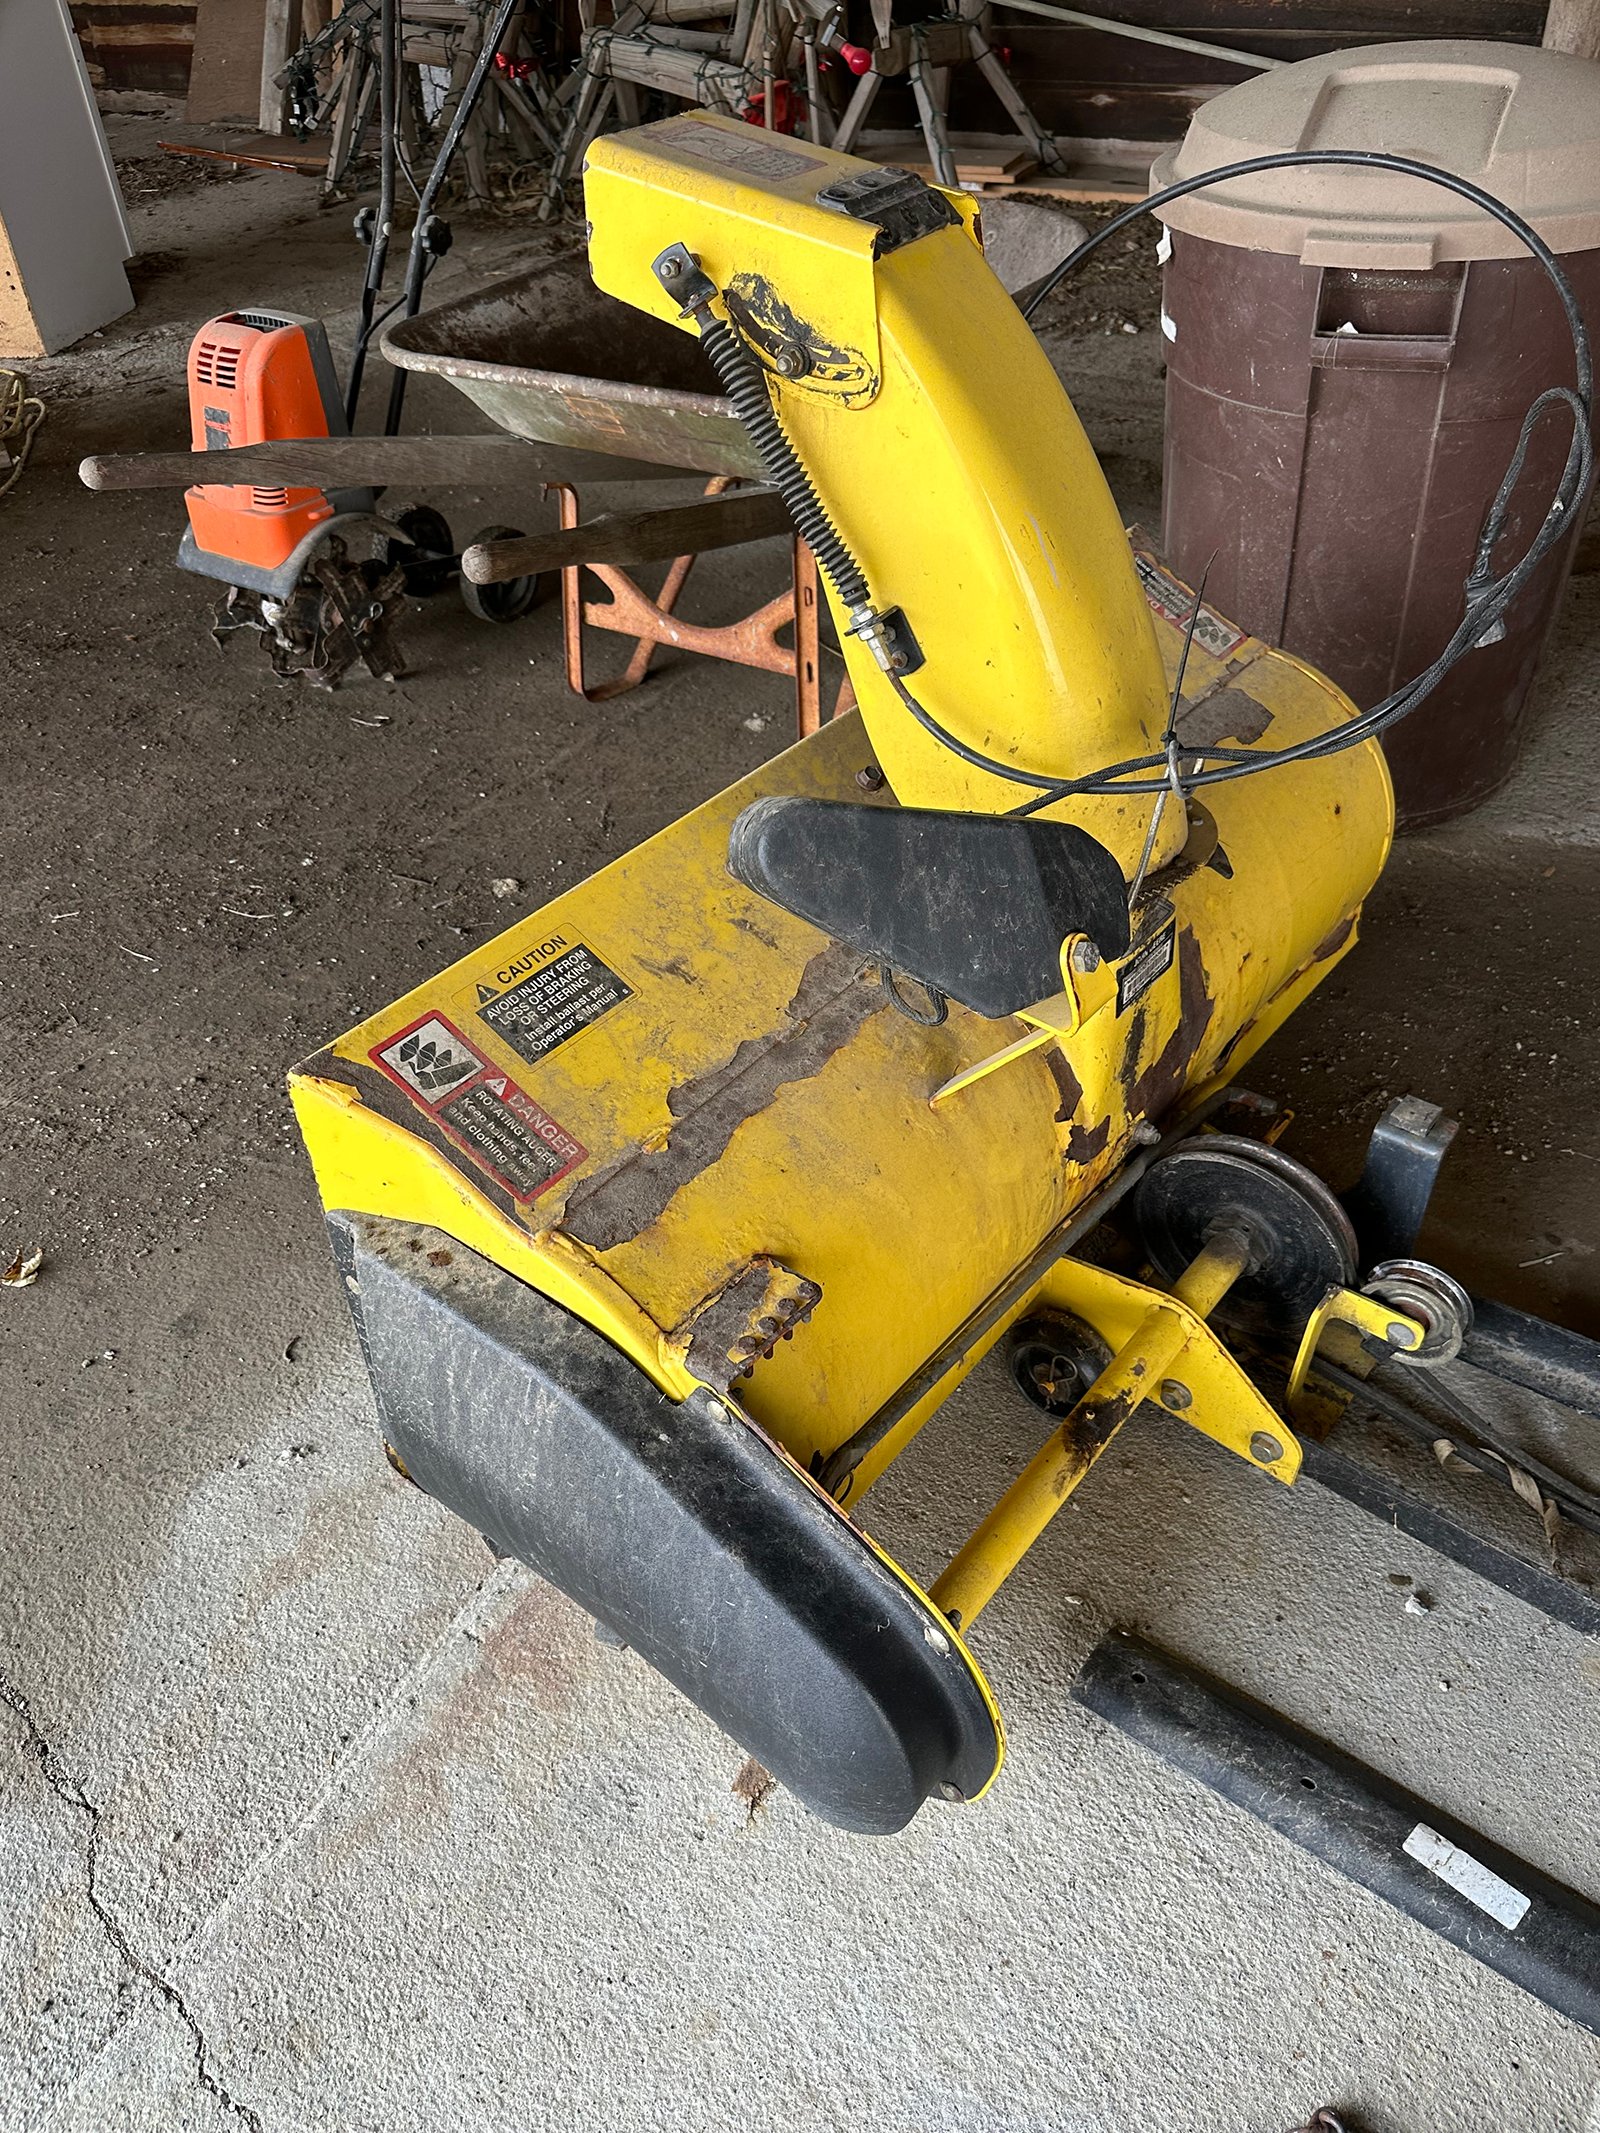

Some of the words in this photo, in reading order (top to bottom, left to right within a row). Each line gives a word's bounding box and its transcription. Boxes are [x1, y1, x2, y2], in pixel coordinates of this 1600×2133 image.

[487, 994, 520, 1020] AVOID
[519, 969, 557, 999] INJURY
[556, 950, 588, 974] FROM
[497, 935, 567, 984] CAUTION
[498, 1002, 530, 1026] LOSS
[529, 991, 544, 1005] OF
[544, 961, 592, 996] BRAKING
[520, 1010, 539, 1025] OR
[537, 977, 589, 1015] STEERING
[525, 1016, 557, 1041] Install
[555, 994, 591, 1020] ballast
[589, 984, 606, 999] per
[531, 1016, 583, 1051] Operator's
[582, 990, 618, 1016] Manual
[449, 1106, 470, 1125] and
[469, 1125, 508, 1164] clothing
[461, 1097, 487, 1123] Keep
[487, 1122, 518, 1156] hands,
[476, 1090, 524, 1136] ROTATING
[522, 1133, 557, 1167] AUGER
[508, 1093, 579, 1158] DANGER
